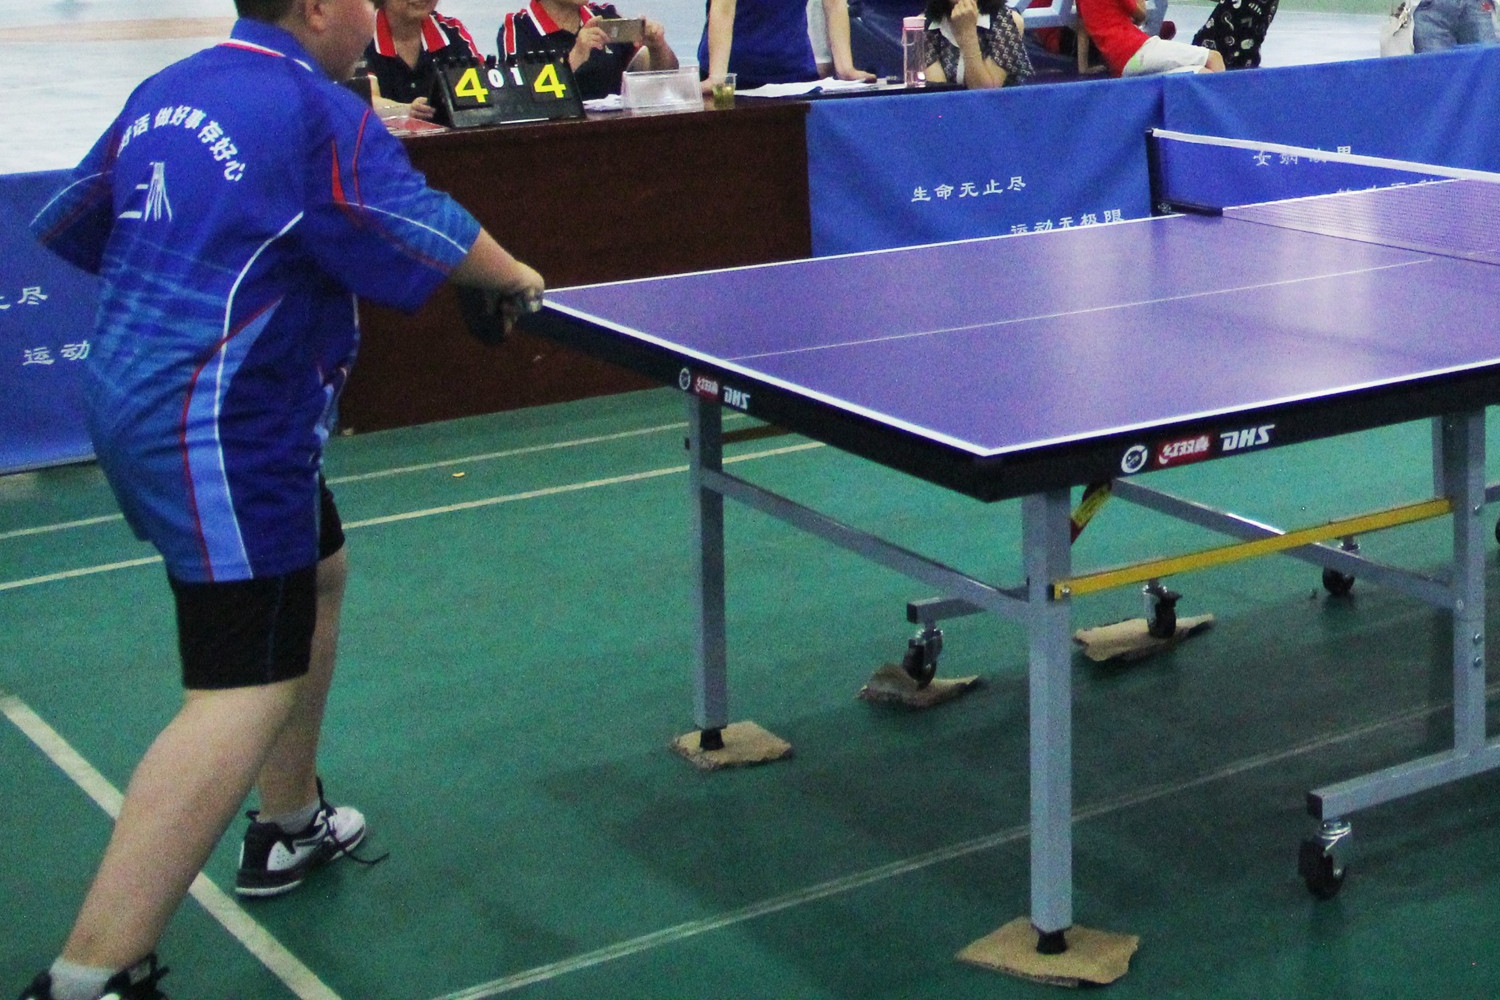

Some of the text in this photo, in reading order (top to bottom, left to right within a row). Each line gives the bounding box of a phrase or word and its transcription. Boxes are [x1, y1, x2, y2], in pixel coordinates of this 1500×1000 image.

[454, 63, 567, 103] 4 0 1 4
[154, 105, 207, 129] 做好事
[198, 120, 246, 182] 存好心
[911, 176, 1026, 203] 生命无止尽
[22, 340, 91, 366] 运动
[1220, 424, 1276, 451] DHS
